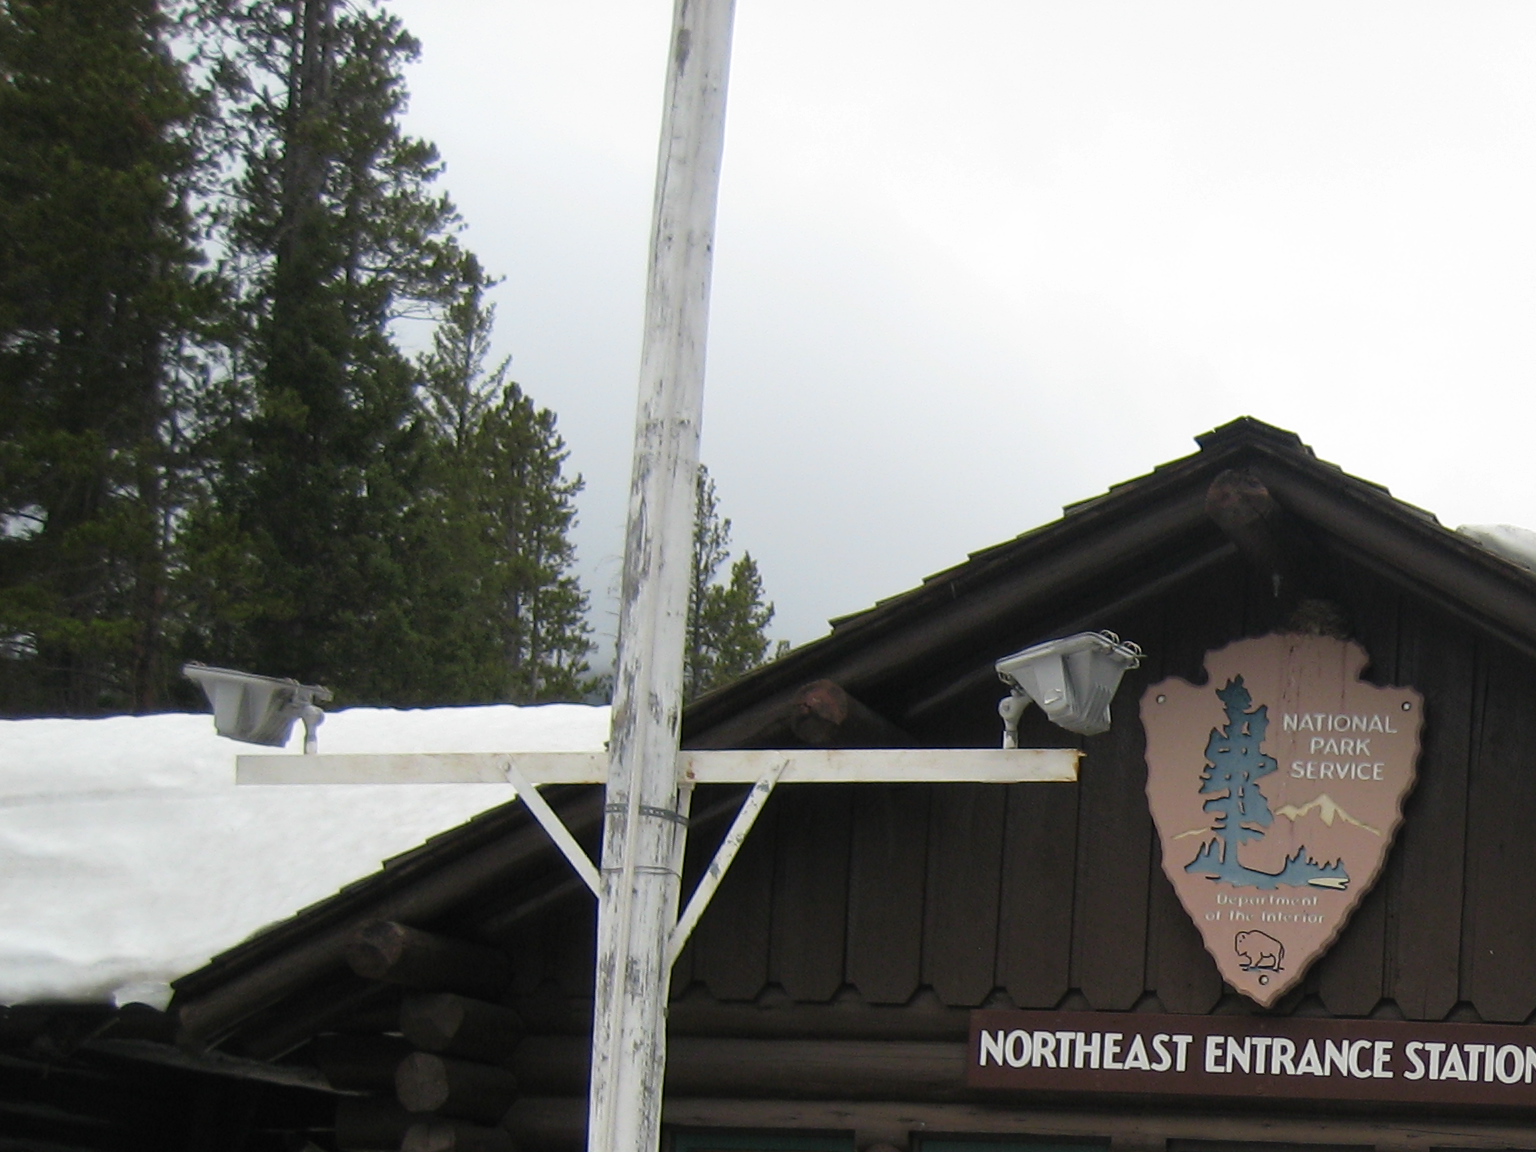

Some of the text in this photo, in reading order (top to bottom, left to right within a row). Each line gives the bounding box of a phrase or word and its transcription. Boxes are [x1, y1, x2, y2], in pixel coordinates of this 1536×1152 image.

[1283, 713, 1397, 733] NATIONAL
[1310, 737, 1370, 756] PARK
[1291, 761, 1384, 780] SERVICE
[1217, 894, 1317, 907] Department
[1205, 910, 1323, 923] of the Interior
[979, 1029, 1193, 1072] NORTHEAST
[1205, 1035, 1394, 1079] ENTRANCE
